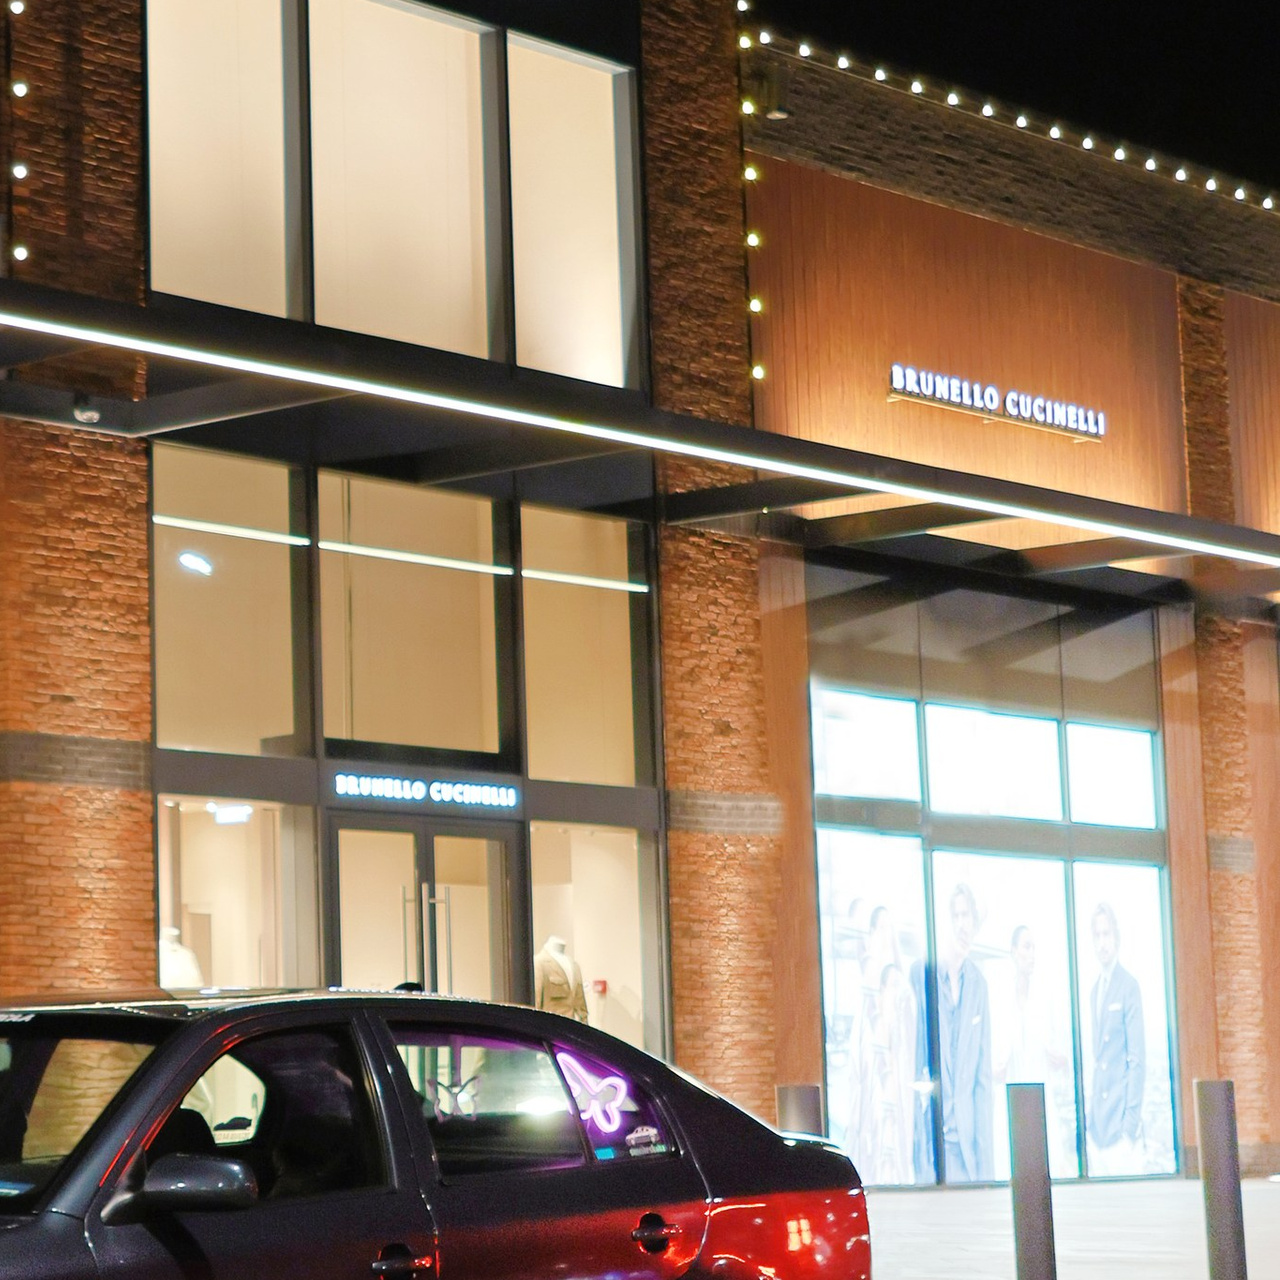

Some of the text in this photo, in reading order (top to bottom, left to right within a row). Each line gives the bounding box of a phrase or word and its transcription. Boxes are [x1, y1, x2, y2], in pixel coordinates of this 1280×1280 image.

[891, 363, 1106, 436] BRUNELLO CUCINELLI
[334, 773, 518, 808] BRUNELLO CUCINELLI
